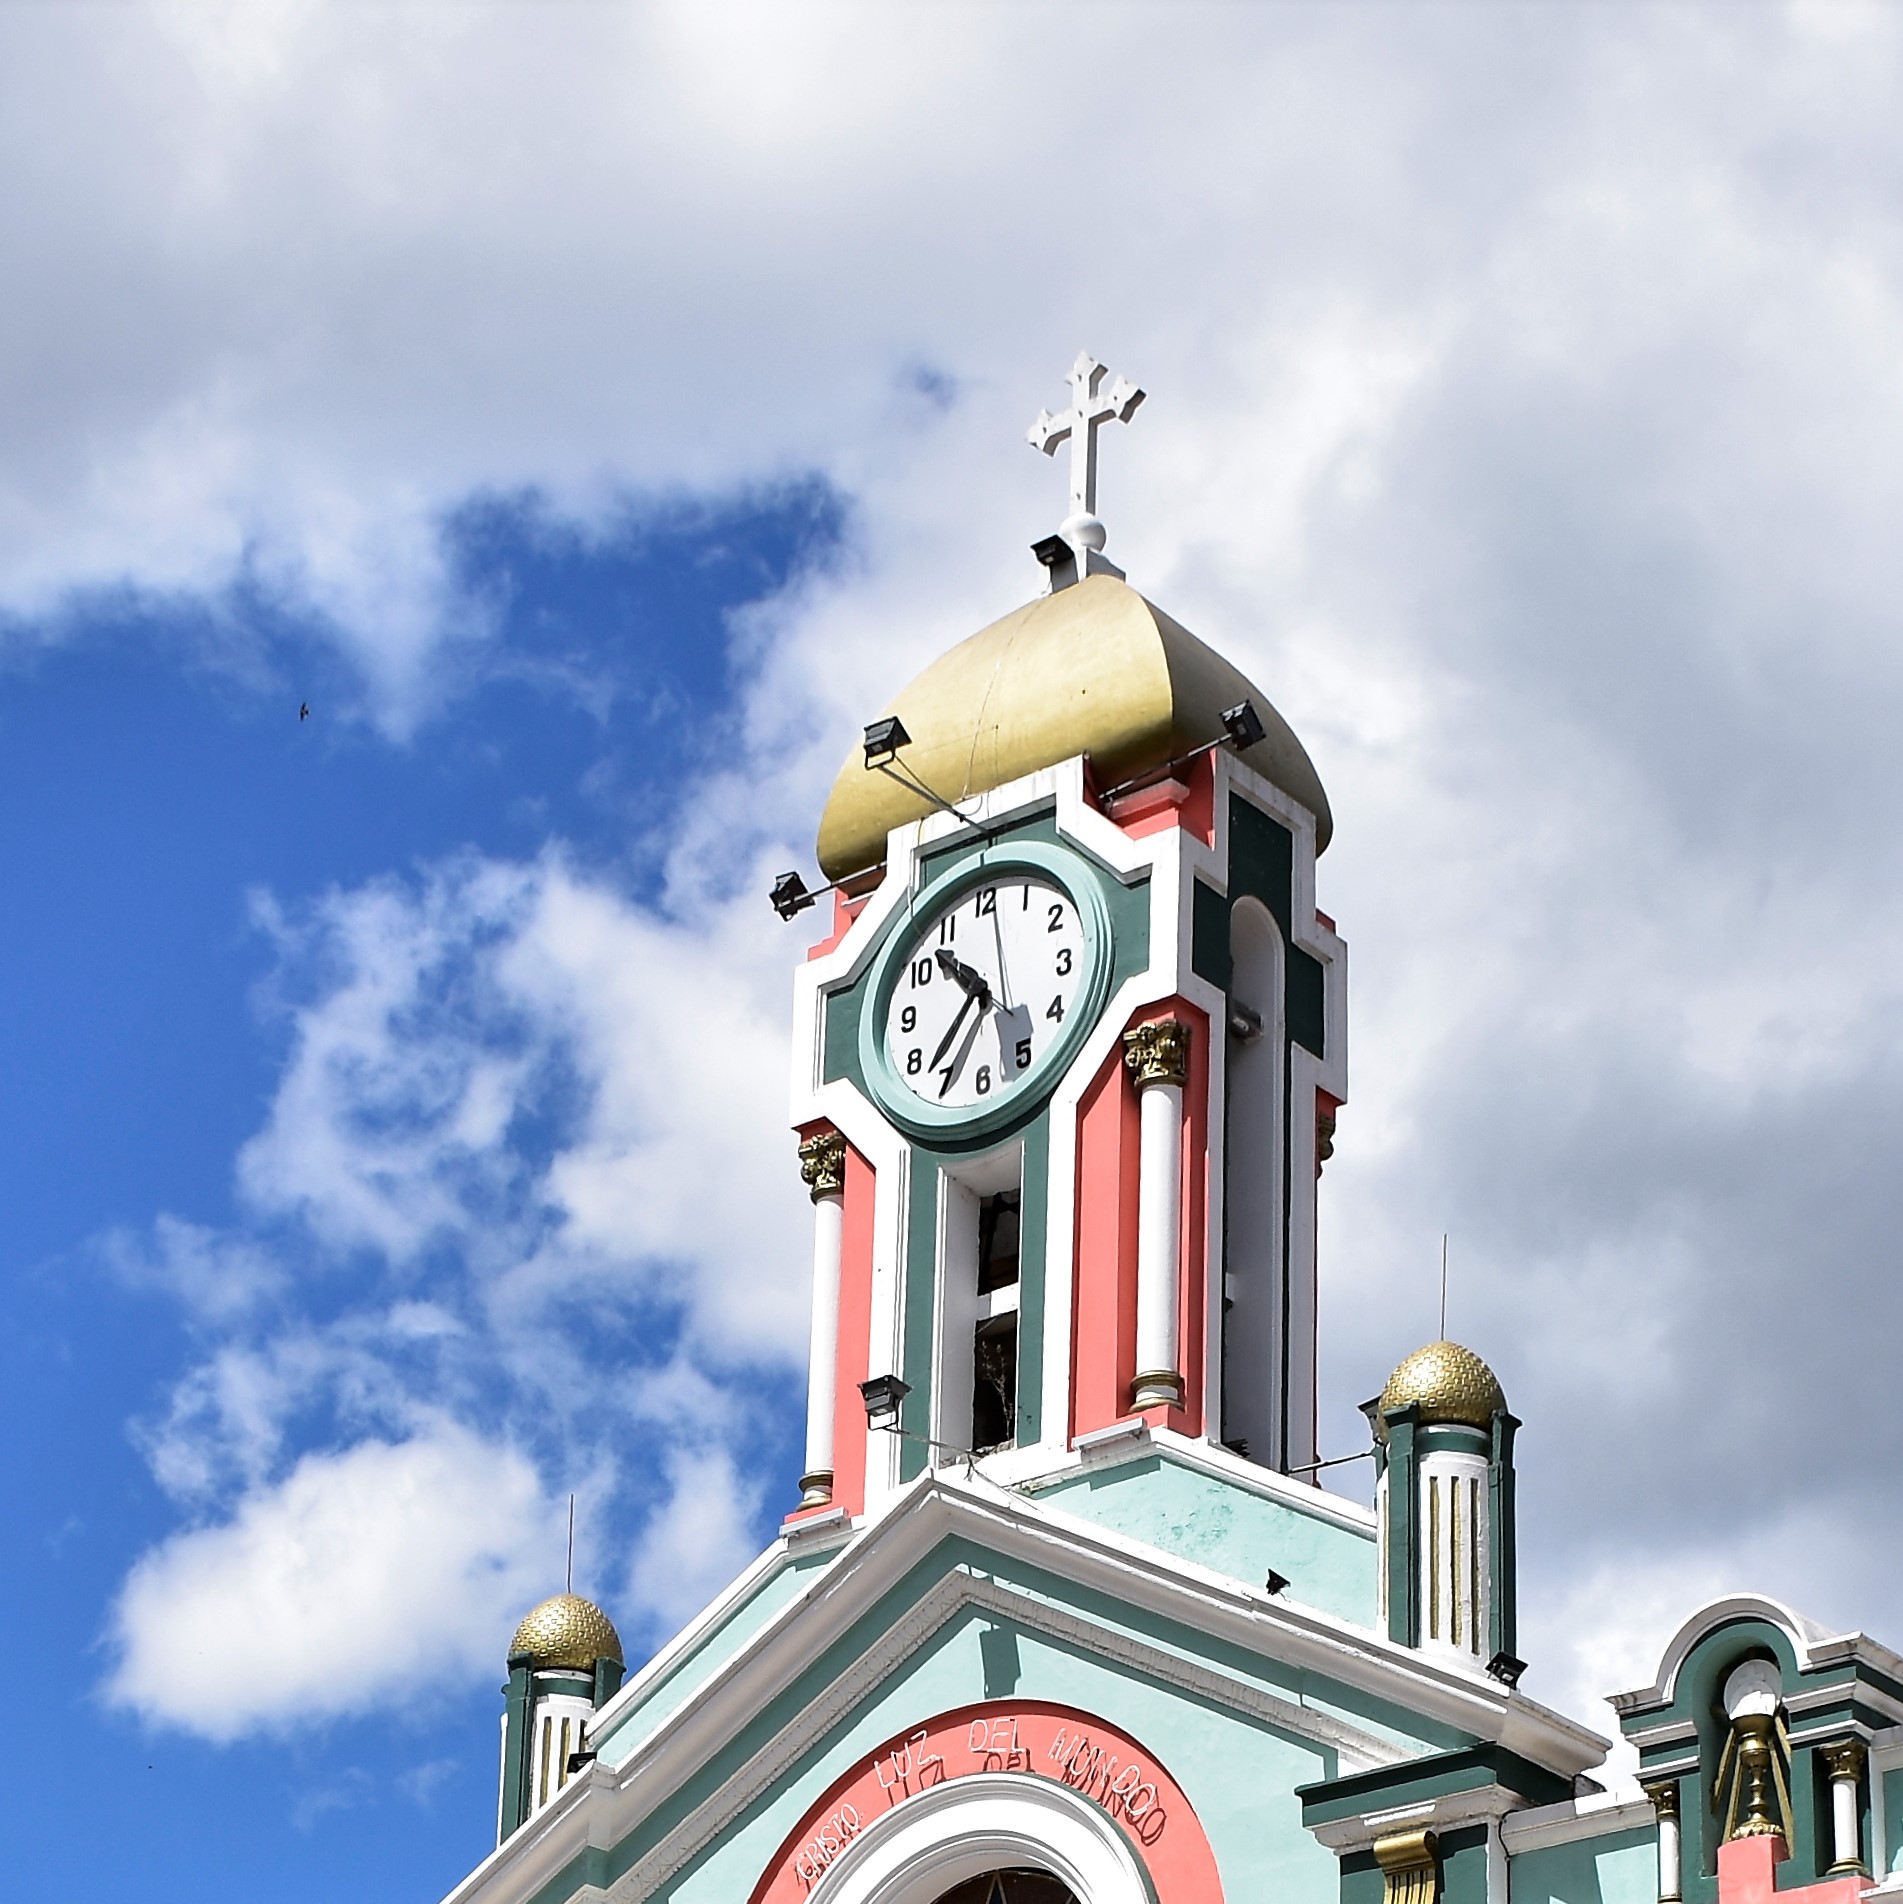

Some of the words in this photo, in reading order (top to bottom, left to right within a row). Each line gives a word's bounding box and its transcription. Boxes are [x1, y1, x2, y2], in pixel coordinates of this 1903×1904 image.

[975, 887, 996, 918] 12
[1022, 884, 1029, 911] 1
[940, 915, 956, 945] 11
[1047, 904, 1064, 932] 2
[911, 958, 933, 990] 10
[1055, 949, 1072, 976] 3
[900, 1006, 917, 1033] 9
[1046, 995, 1064, 1023] 4
[906, 1048, 922, 1075] 8
[1015, 1037, 1032, 1069] 5
[939, 1066, 954, 1099] 7
[975, 1065, 991, 1095] 6
[796, 1803, 861, 1883] CRISTO
[873, 1729, 944, 1789] LUZ
[968, 1718, 1027, 1753] DEL
[1048, 1727, 1159, 1817] MUNDO
